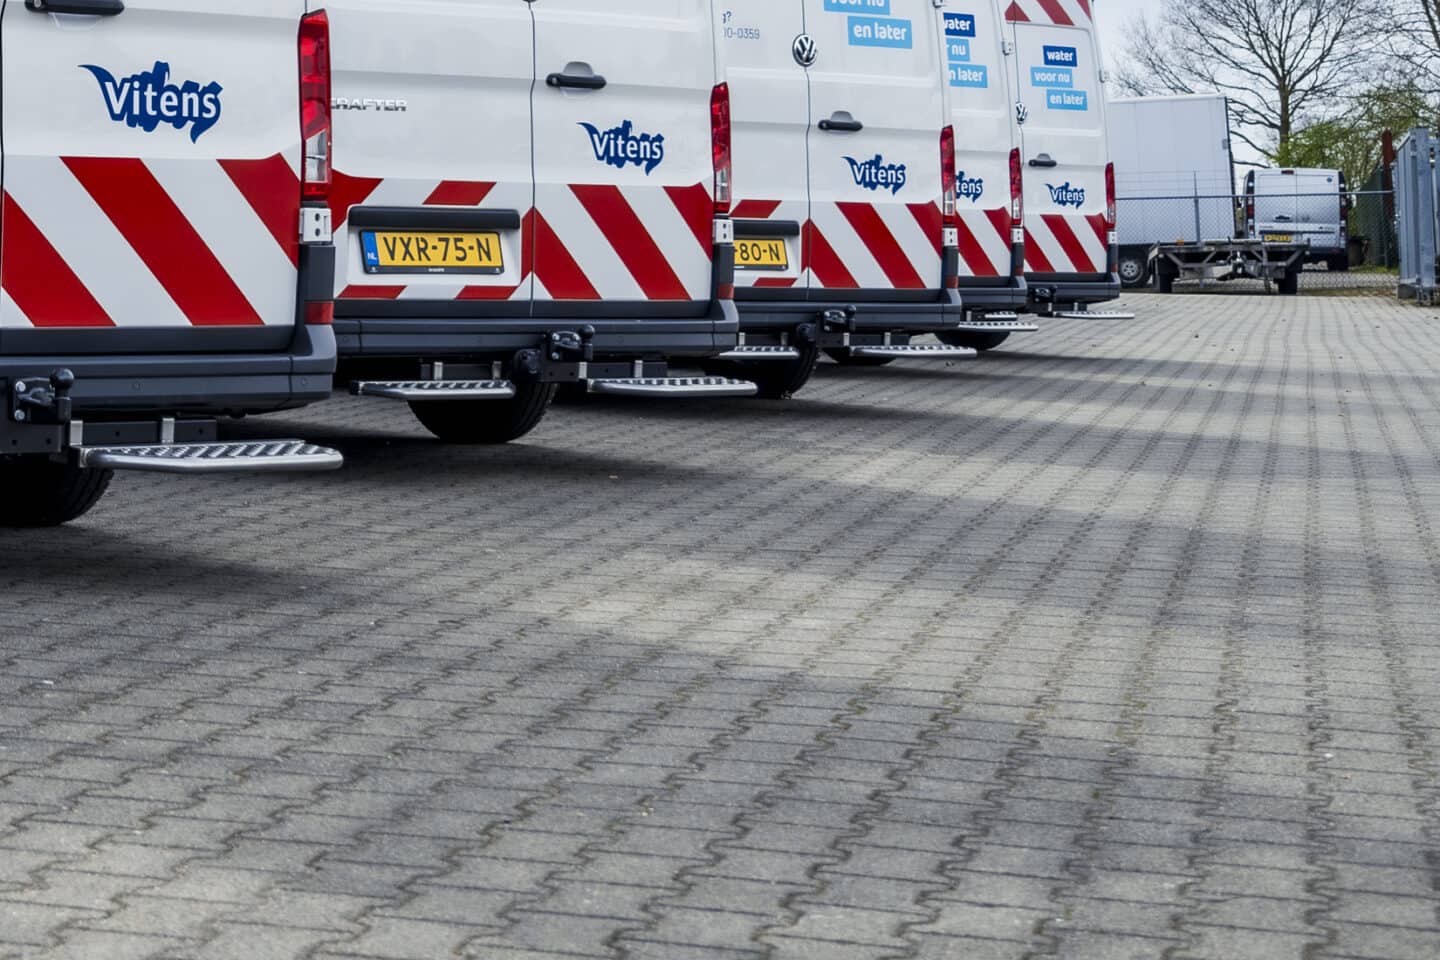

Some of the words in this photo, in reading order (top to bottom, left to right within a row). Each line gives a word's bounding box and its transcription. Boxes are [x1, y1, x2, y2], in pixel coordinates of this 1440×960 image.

[853, 24, 872, 39] en
[874, 22, 907, 41] later
[1046, 50, 1073, 62] water
[958, 67, 984, 82] later
[1034, 71, 1057, 82] voor
[1058, 73, 1070, 83] nu
[103, 80, 219, 119] Vitens
[1050, 95, 1062, 105] en
[1063, 93, 1084, 105] later
[591, 132, 661, 159] Vitens
[852, 163, 906, 185] Vitens
[383, 236, 492, 262] VXR-75-N
[734, 242, 781, 262] -80-N
